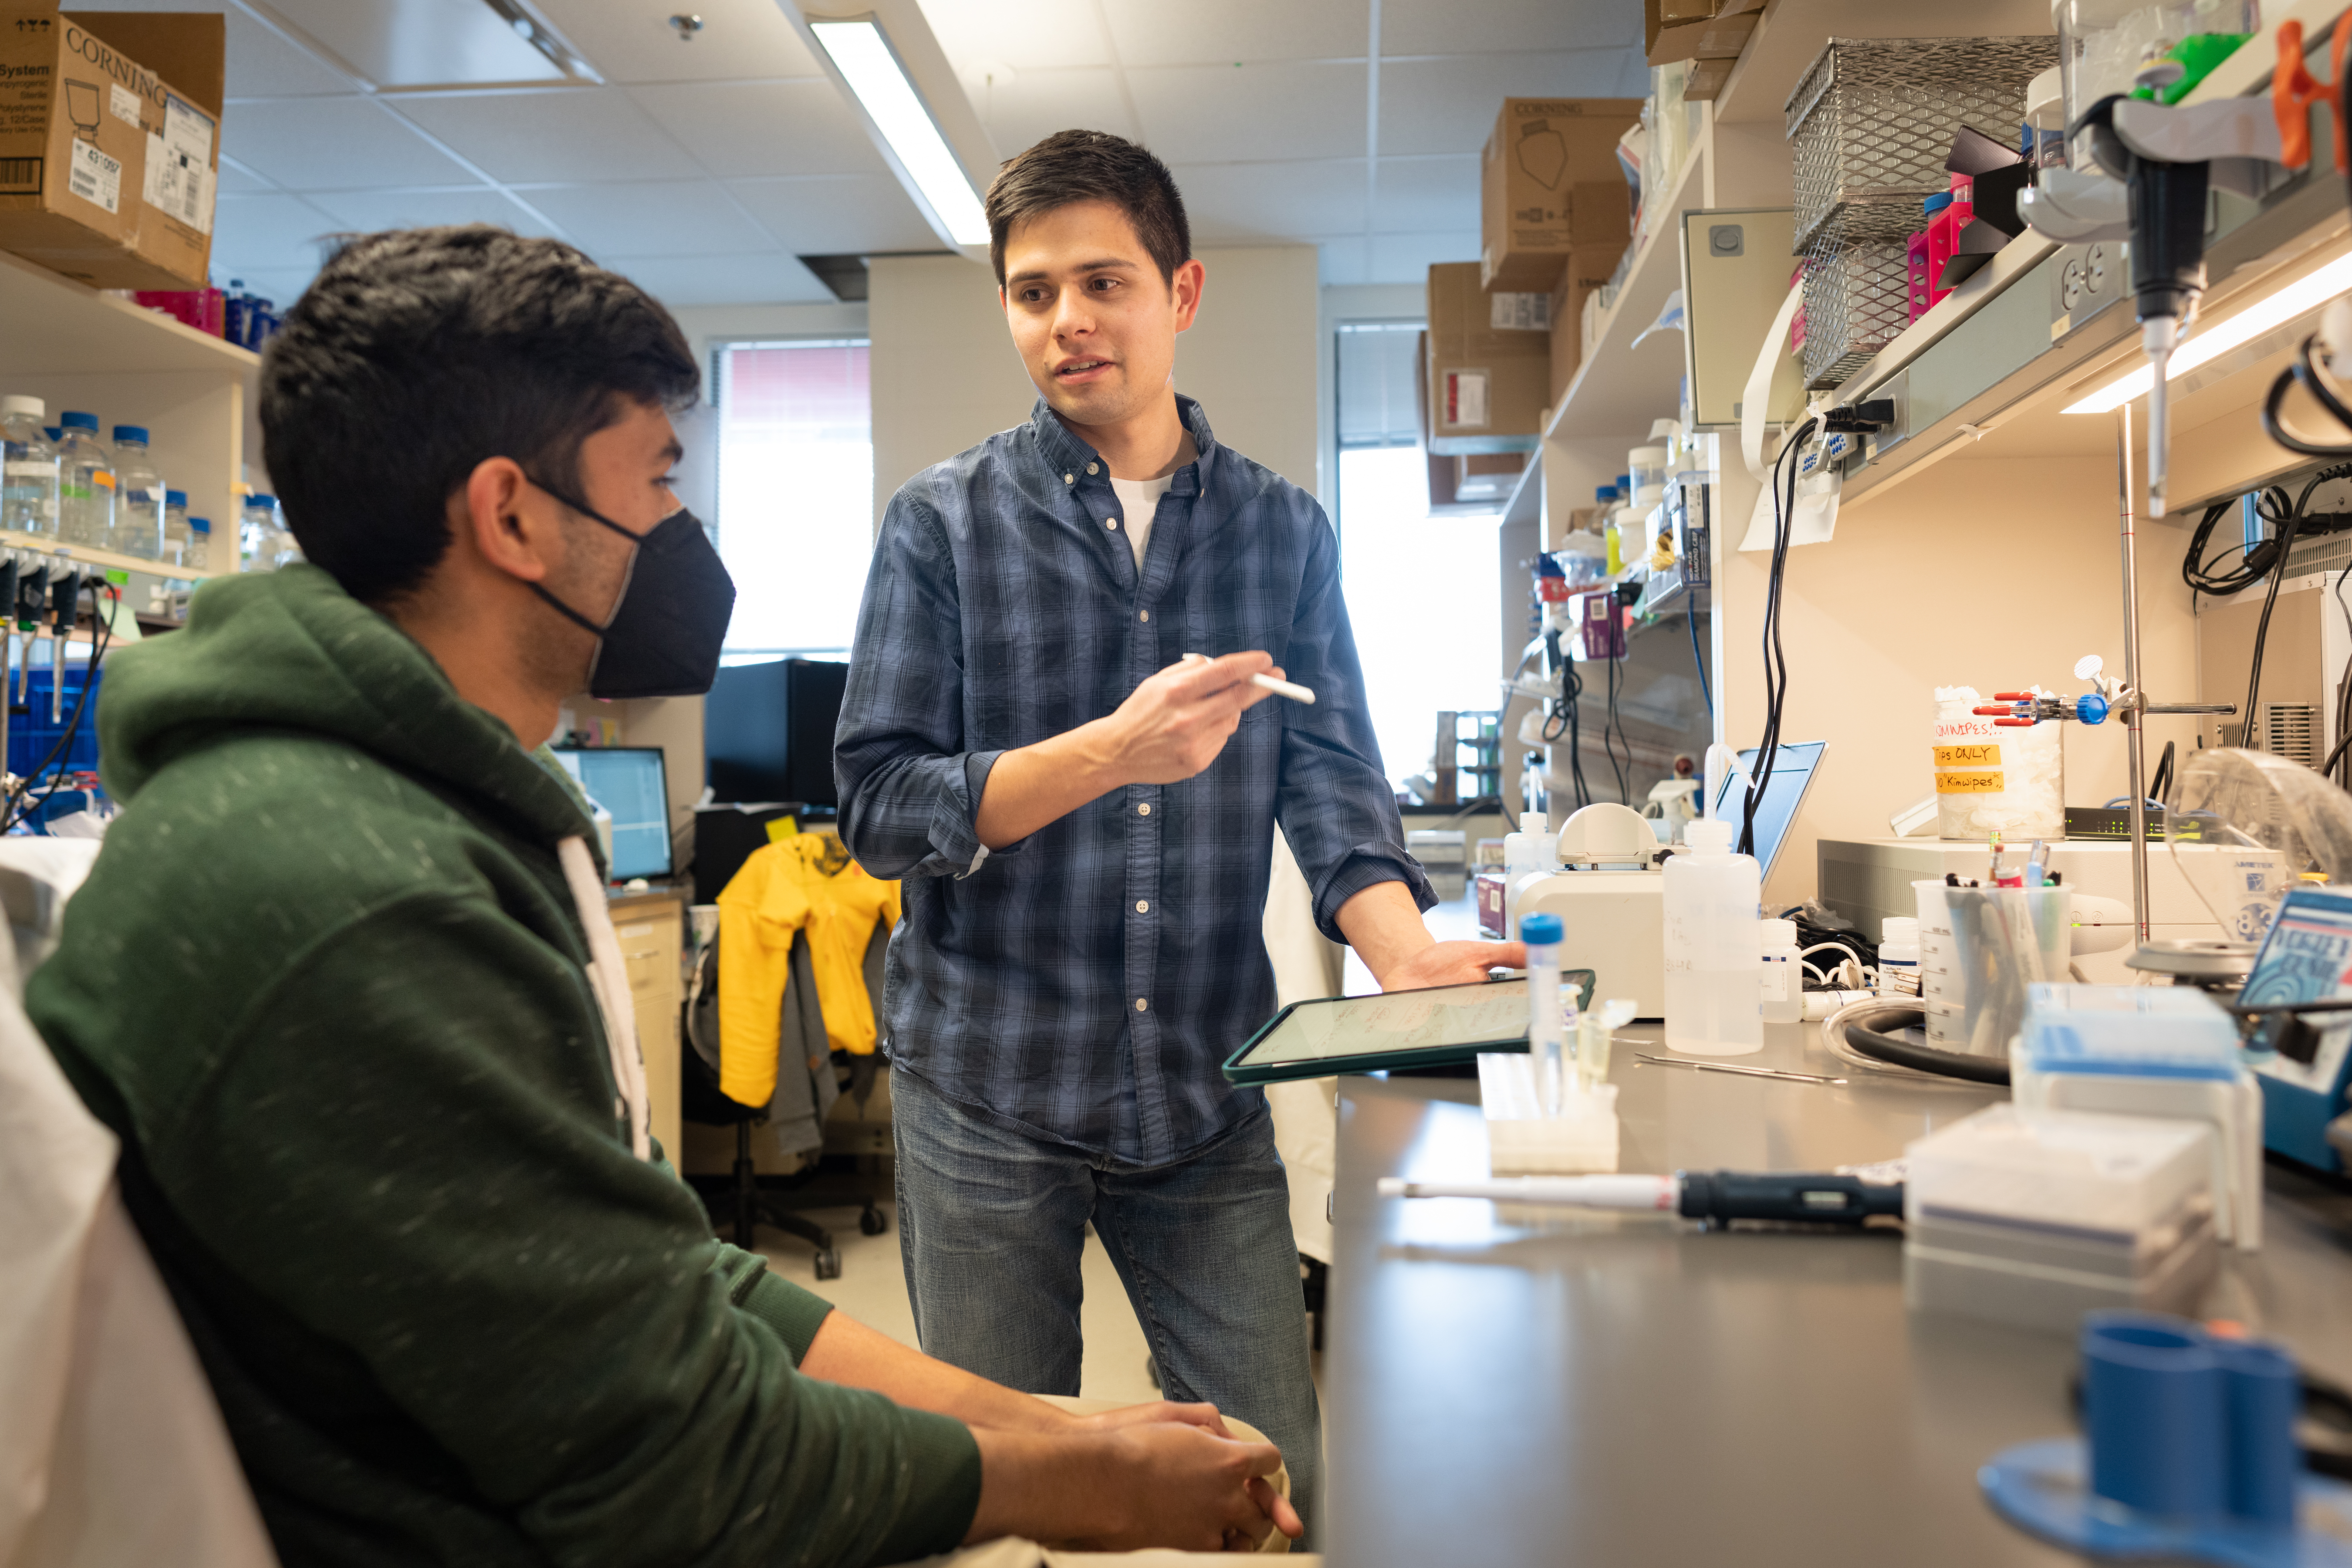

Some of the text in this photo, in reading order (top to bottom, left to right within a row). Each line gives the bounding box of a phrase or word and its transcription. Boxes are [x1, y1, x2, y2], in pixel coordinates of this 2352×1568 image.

[0, 64, 49, 79] System
[67, 27, 167, 109] CORNING
[1514, 103, 1583, 118] CORNING
[1936, 747, 1990, 761] Tips ONLY
